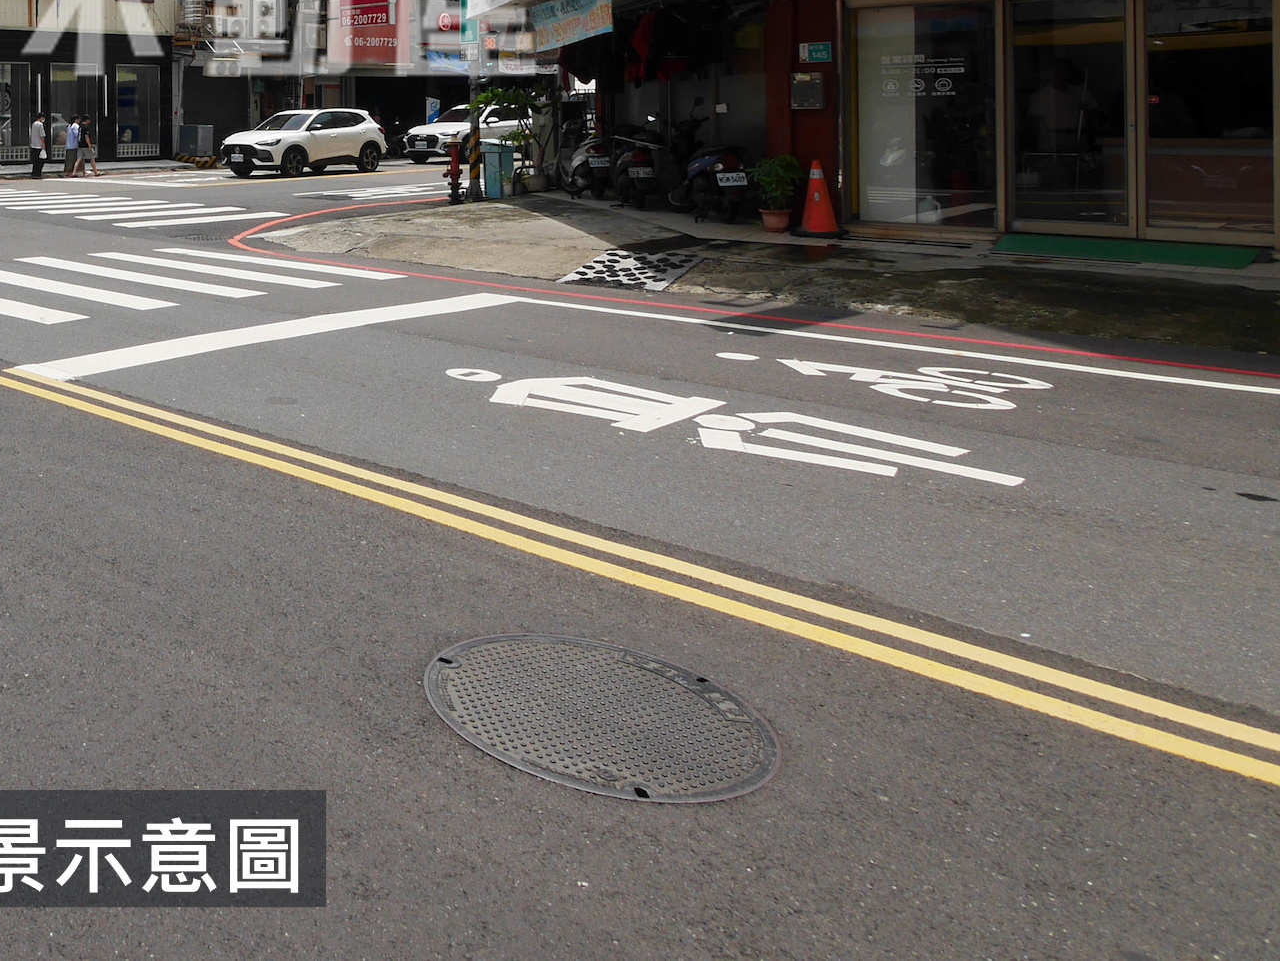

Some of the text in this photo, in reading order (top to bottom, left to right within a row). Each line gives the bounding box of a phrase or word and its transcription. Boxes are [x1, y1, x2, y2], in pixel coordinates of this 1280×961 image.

[342, 13, 387, 26] 06-2007729
[354, 37, 397, 47] 06-2007729
[484, 38, 496, 50] 38
[811, 51, 827, 59] 145
